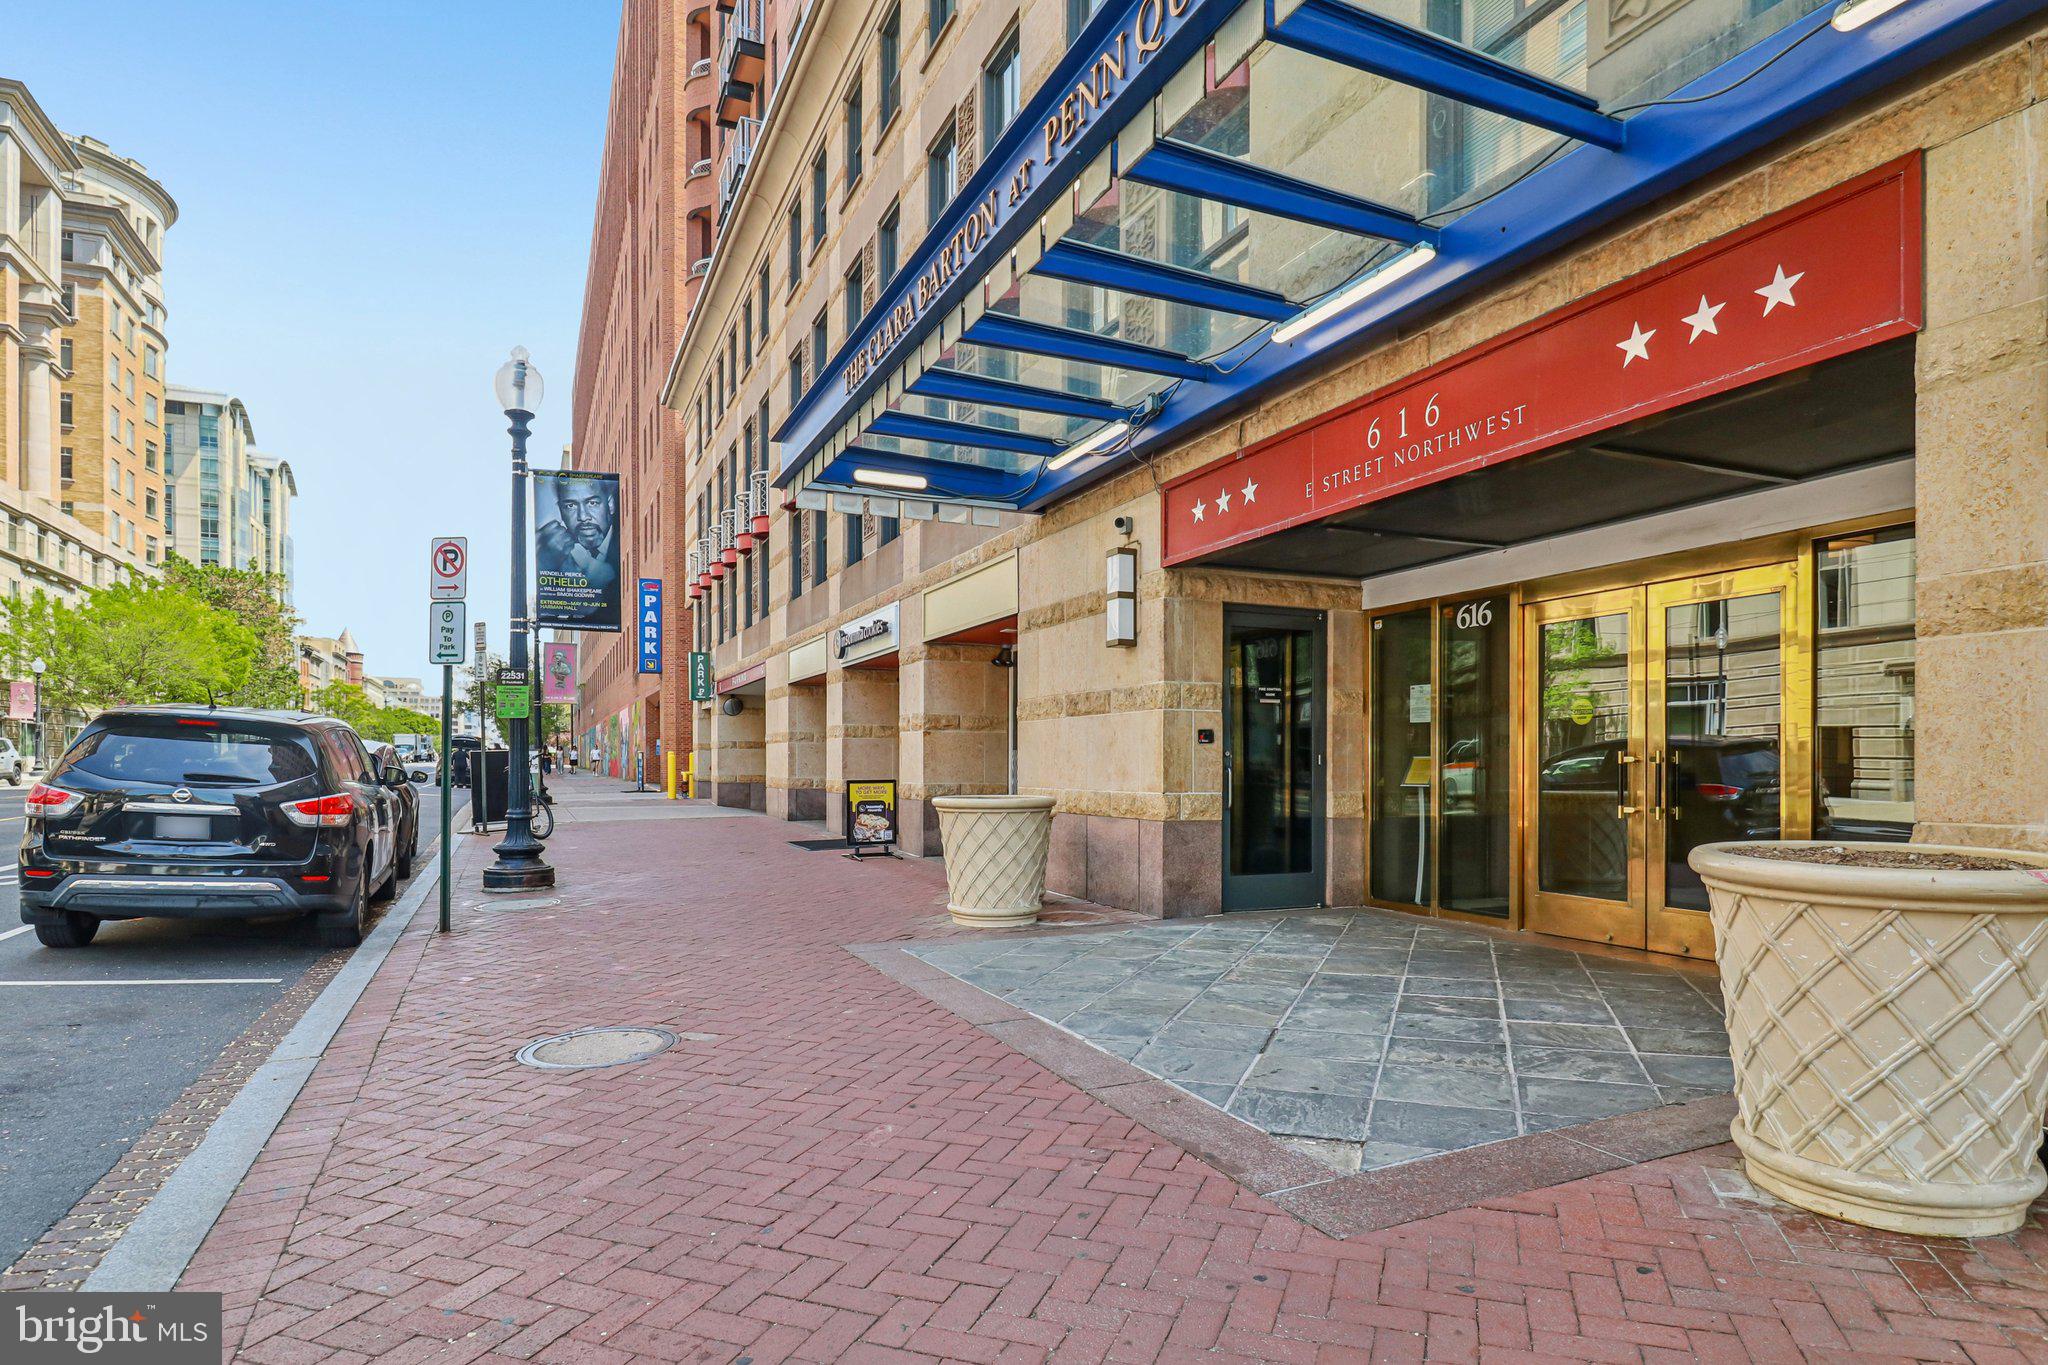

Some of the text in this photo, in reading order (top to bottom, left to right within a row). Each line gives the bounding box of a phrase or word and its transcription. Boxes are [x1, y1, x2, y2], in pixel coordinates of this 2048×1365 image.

[842, 0, 1191, 395] THE CLARA BARTON AT PENN Q
[1305, 404, 1528, 499] E STREET NORTHWEST
[539, 576, 588, 588] OTHELLO
[643, 595, 658, 654] PARK
[1456, 600, 1492, 629] 616
[440, 626, 455, 635] Pay
[443, 635, 452, 643] To
[439, 643, 456, 651] Park
[501, 672, 525, 680] 22531
[697, 654, 705, 687] PARK
